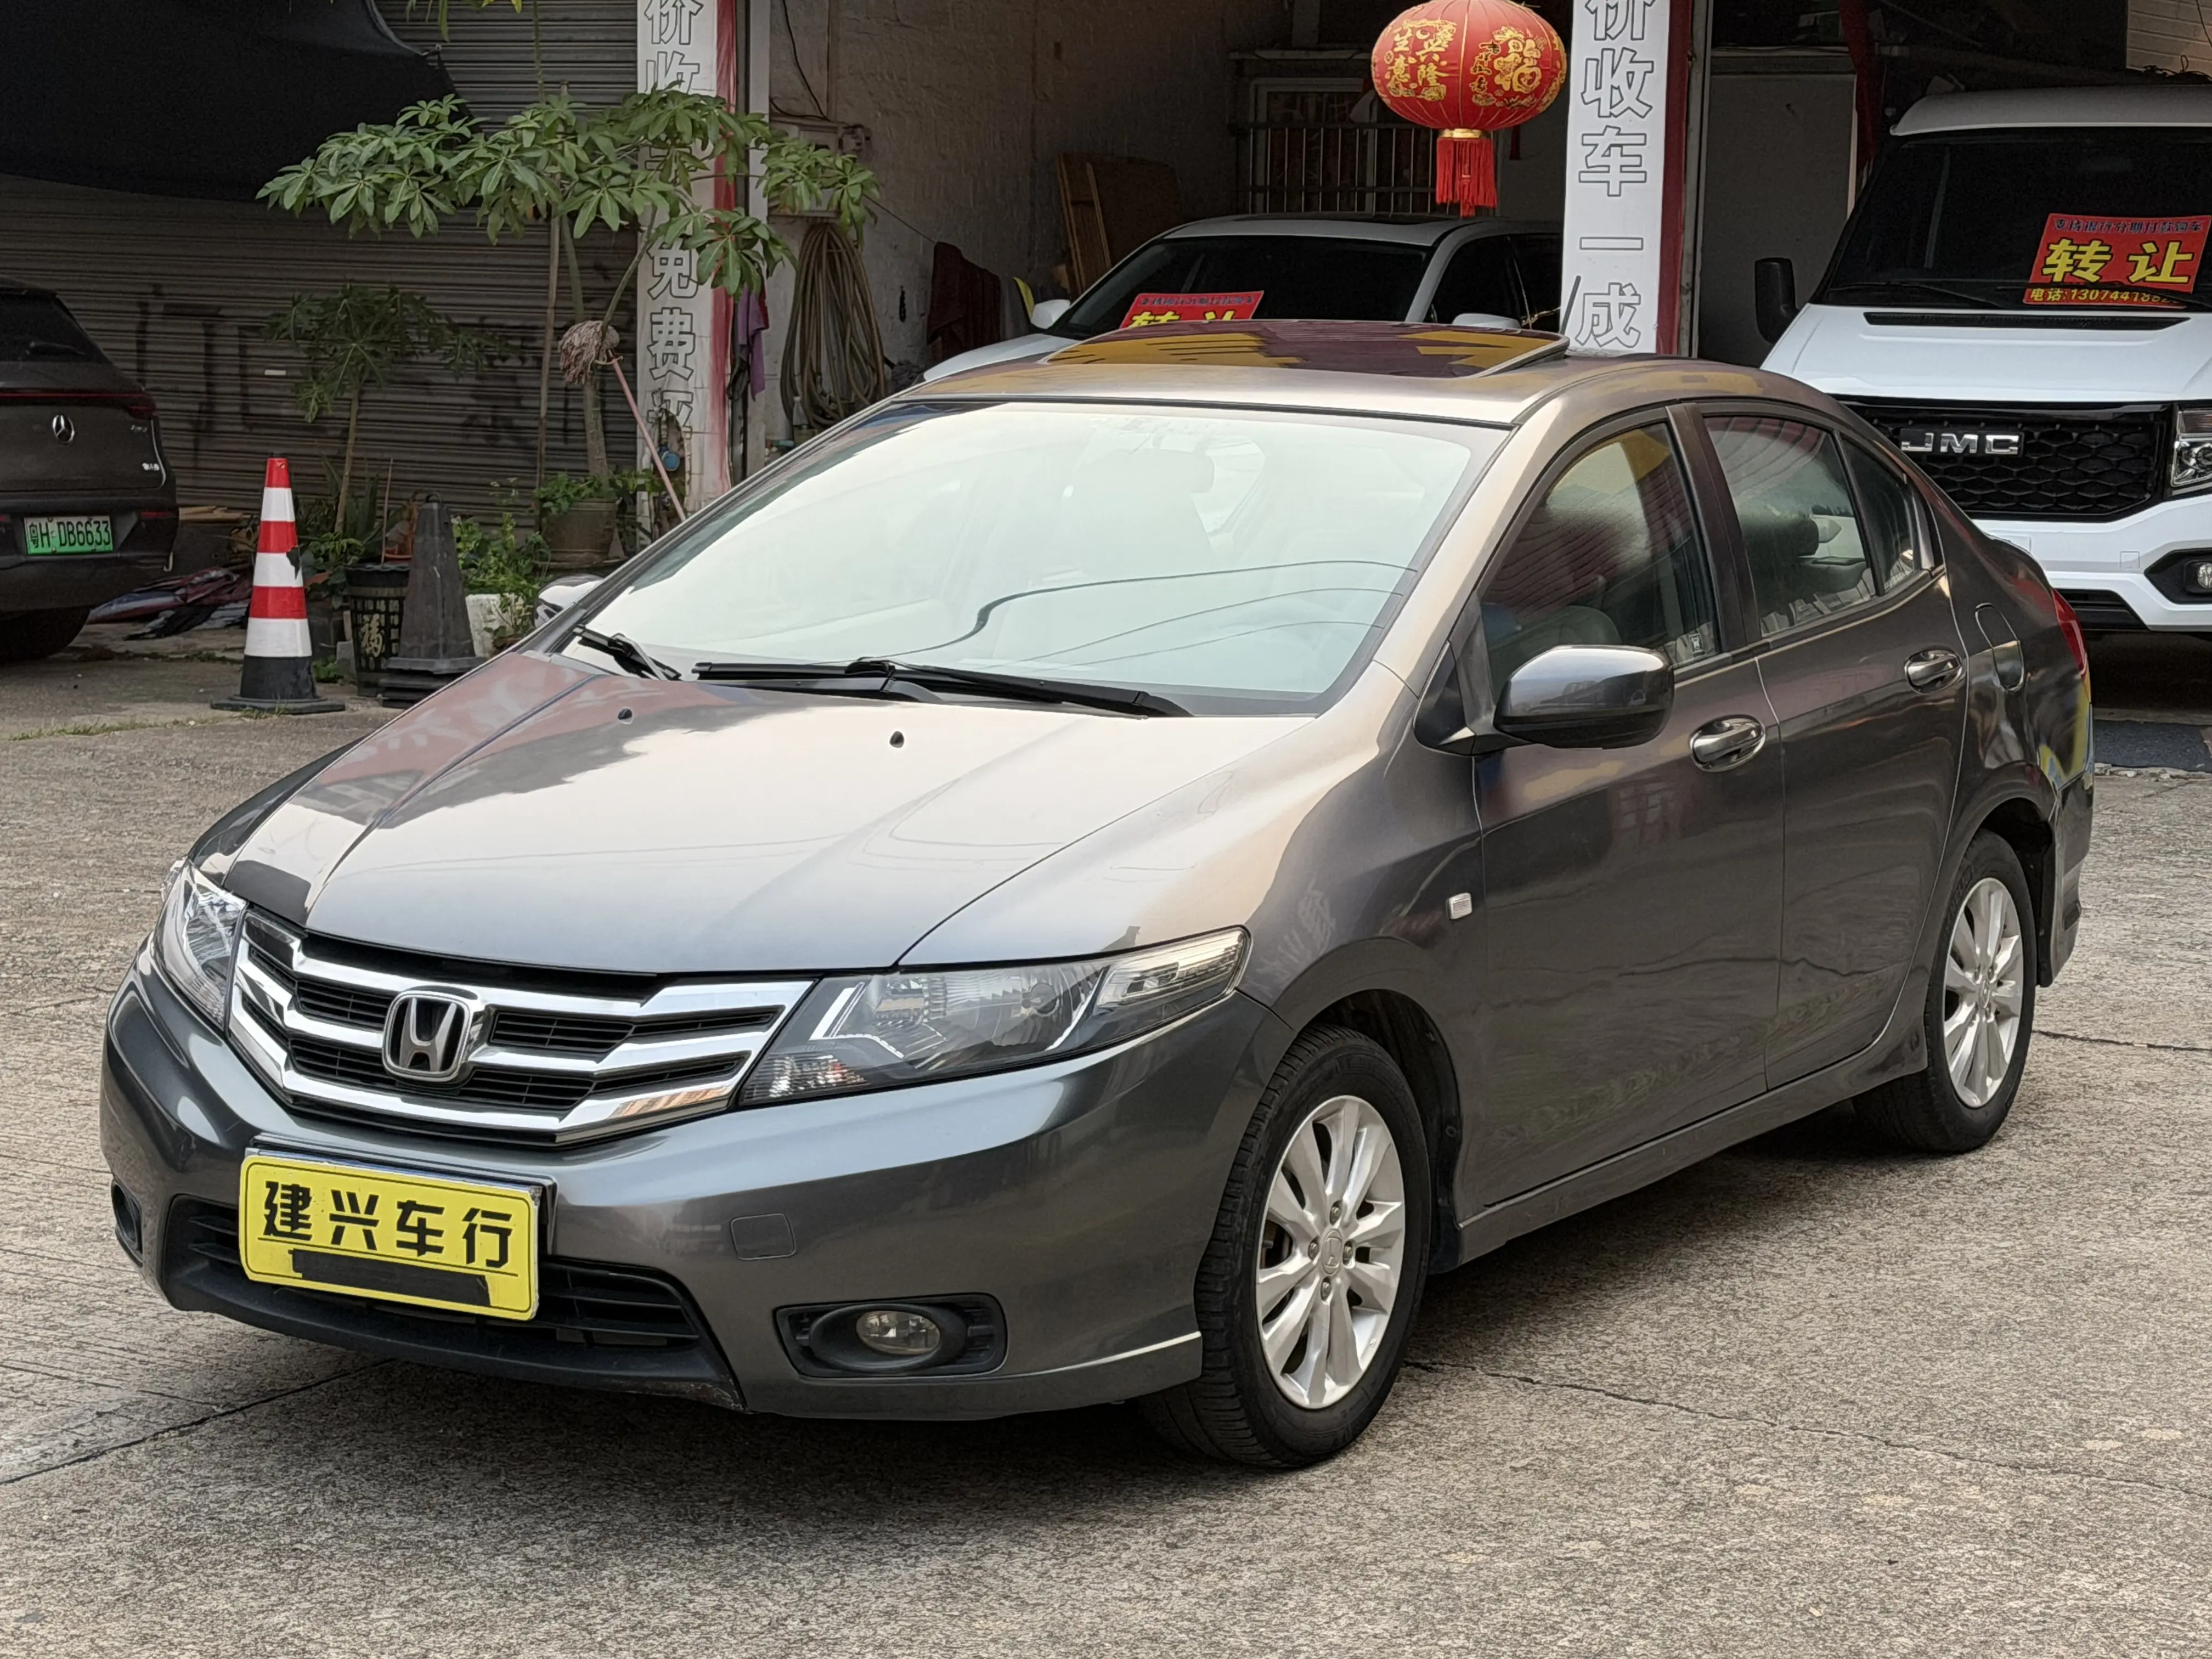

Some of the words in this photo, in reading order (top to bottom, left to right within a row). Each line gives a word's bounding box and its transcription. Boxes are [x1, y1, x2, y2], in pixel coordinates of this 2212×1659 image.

[2042, 238, 2194, 284] 转让
[1900, 432, 2019, 455] JMC
[263, 1180, 514, 1268] 建兴车行
